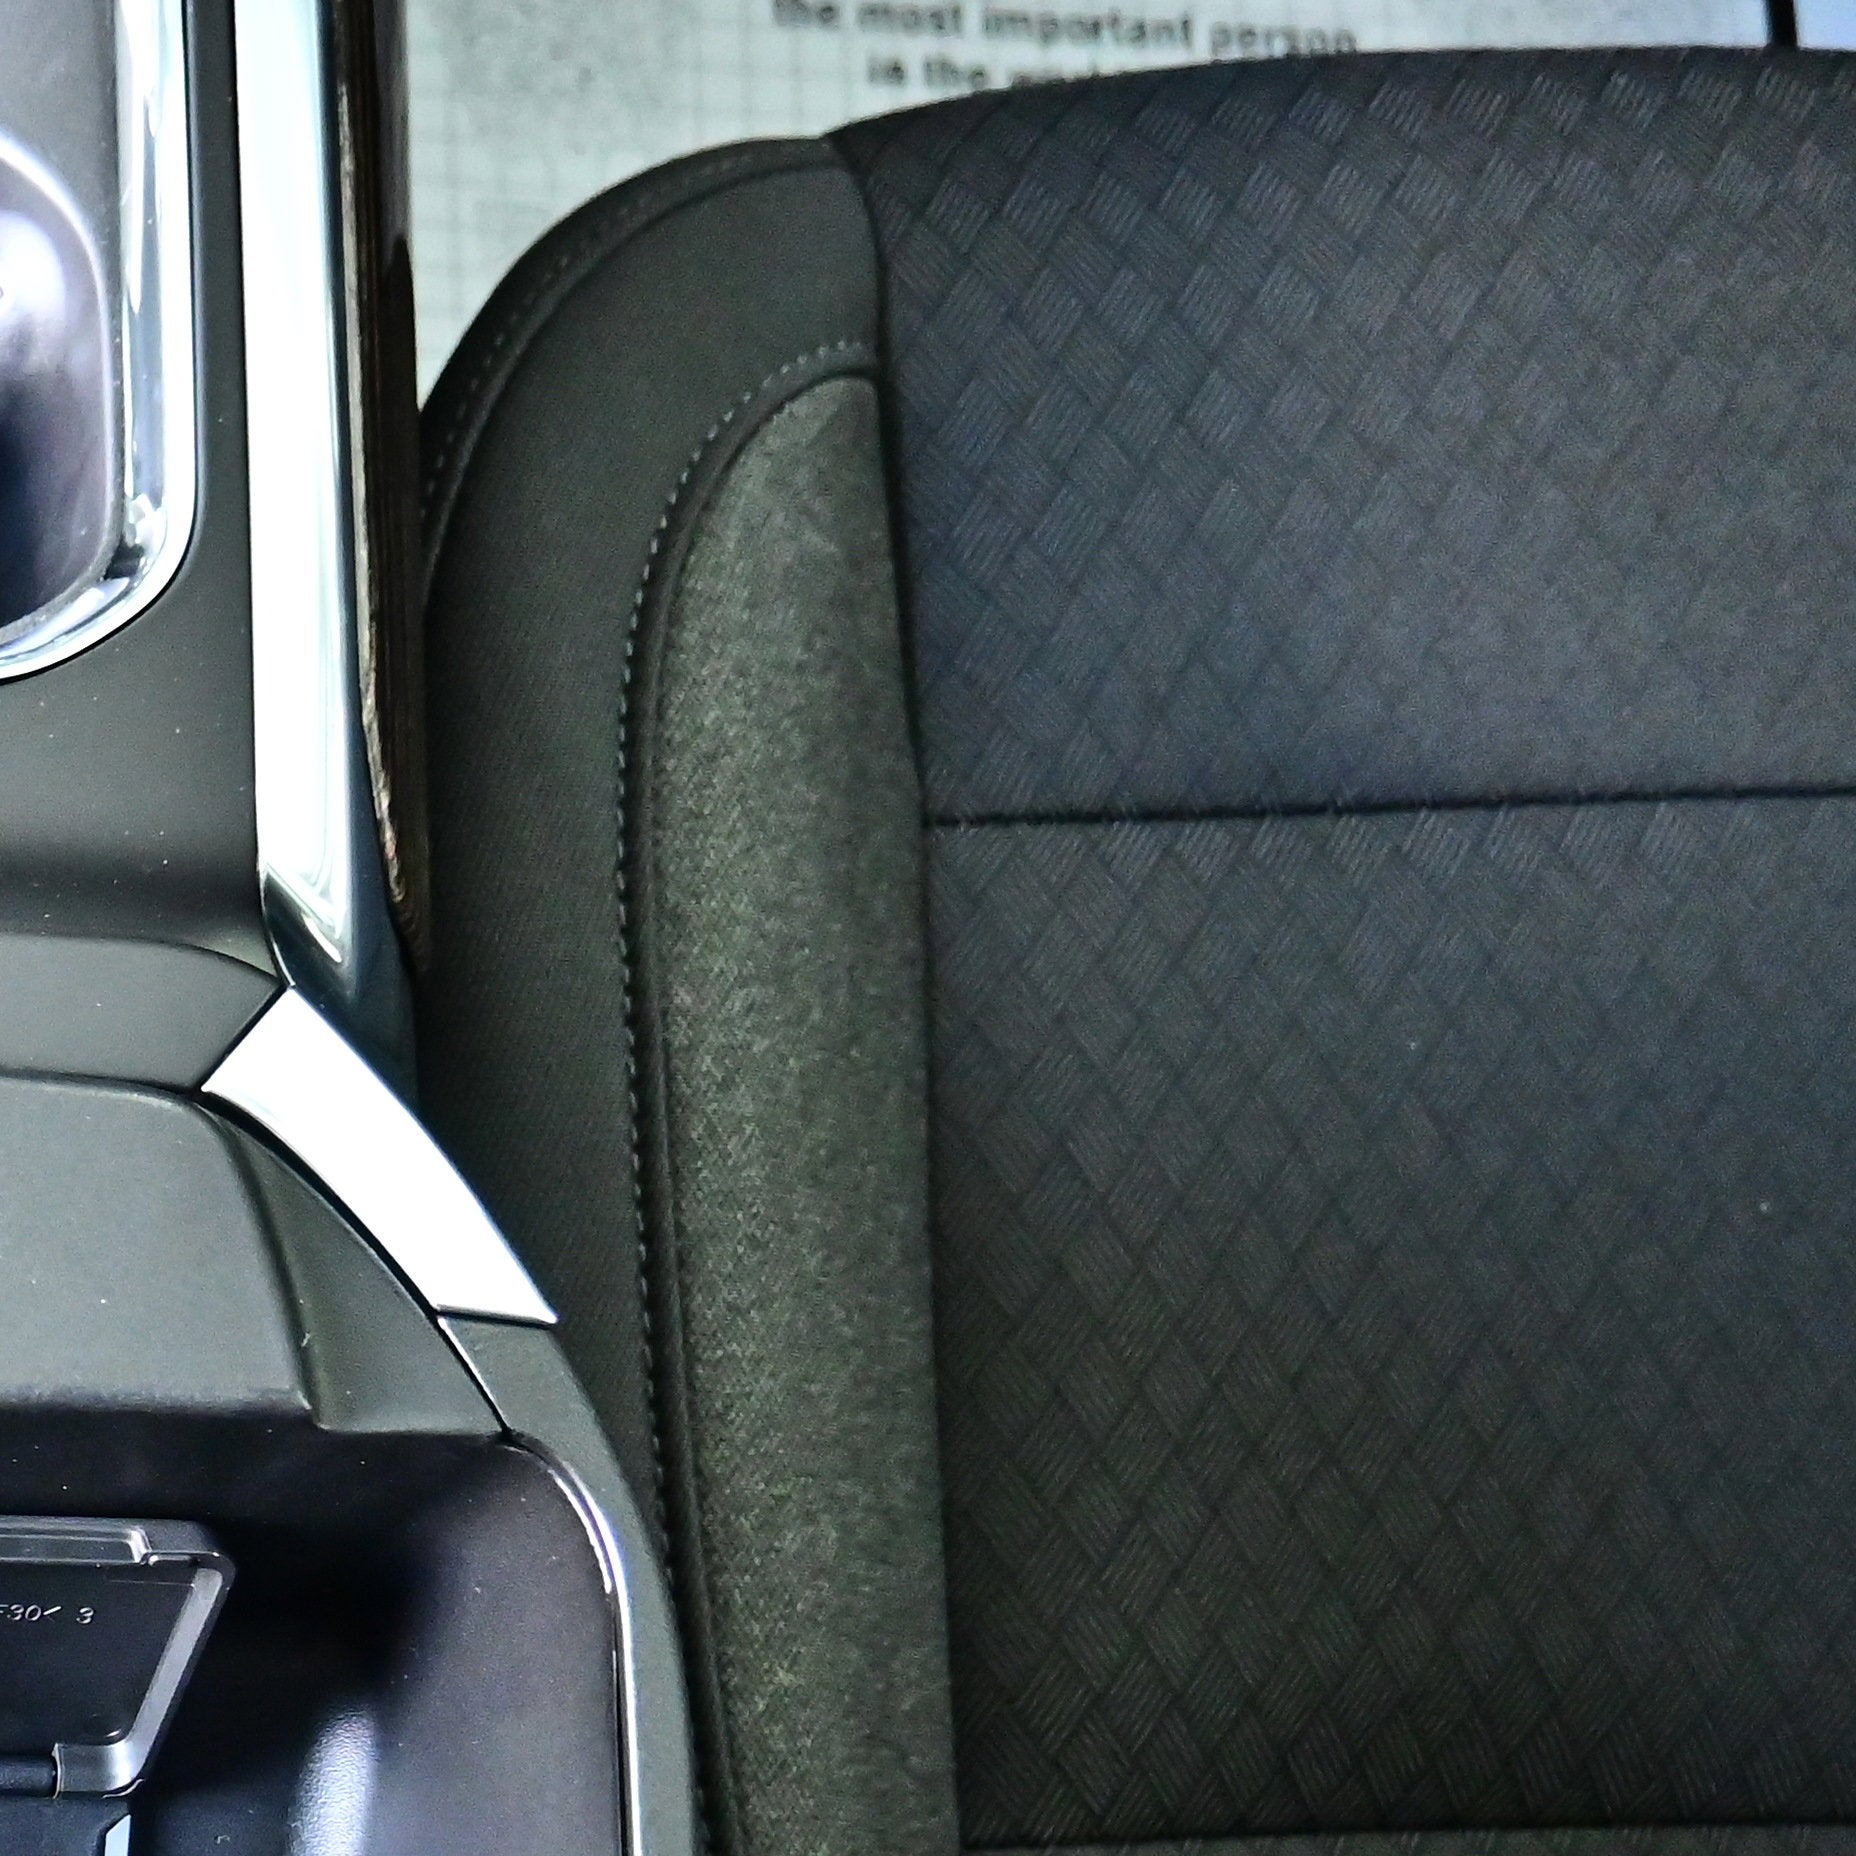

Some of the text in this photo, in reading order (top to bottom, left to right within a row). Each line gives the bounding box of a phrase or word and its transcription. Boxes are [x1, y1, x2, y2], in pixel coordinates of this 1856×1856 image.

[855, 3, 963, 36] most
[982, 8, 1193, 48] important
[1209, 20, 1357, 58] person
[925, 54, 985, 88] the
[75, 1606, 95, 1625] 3
